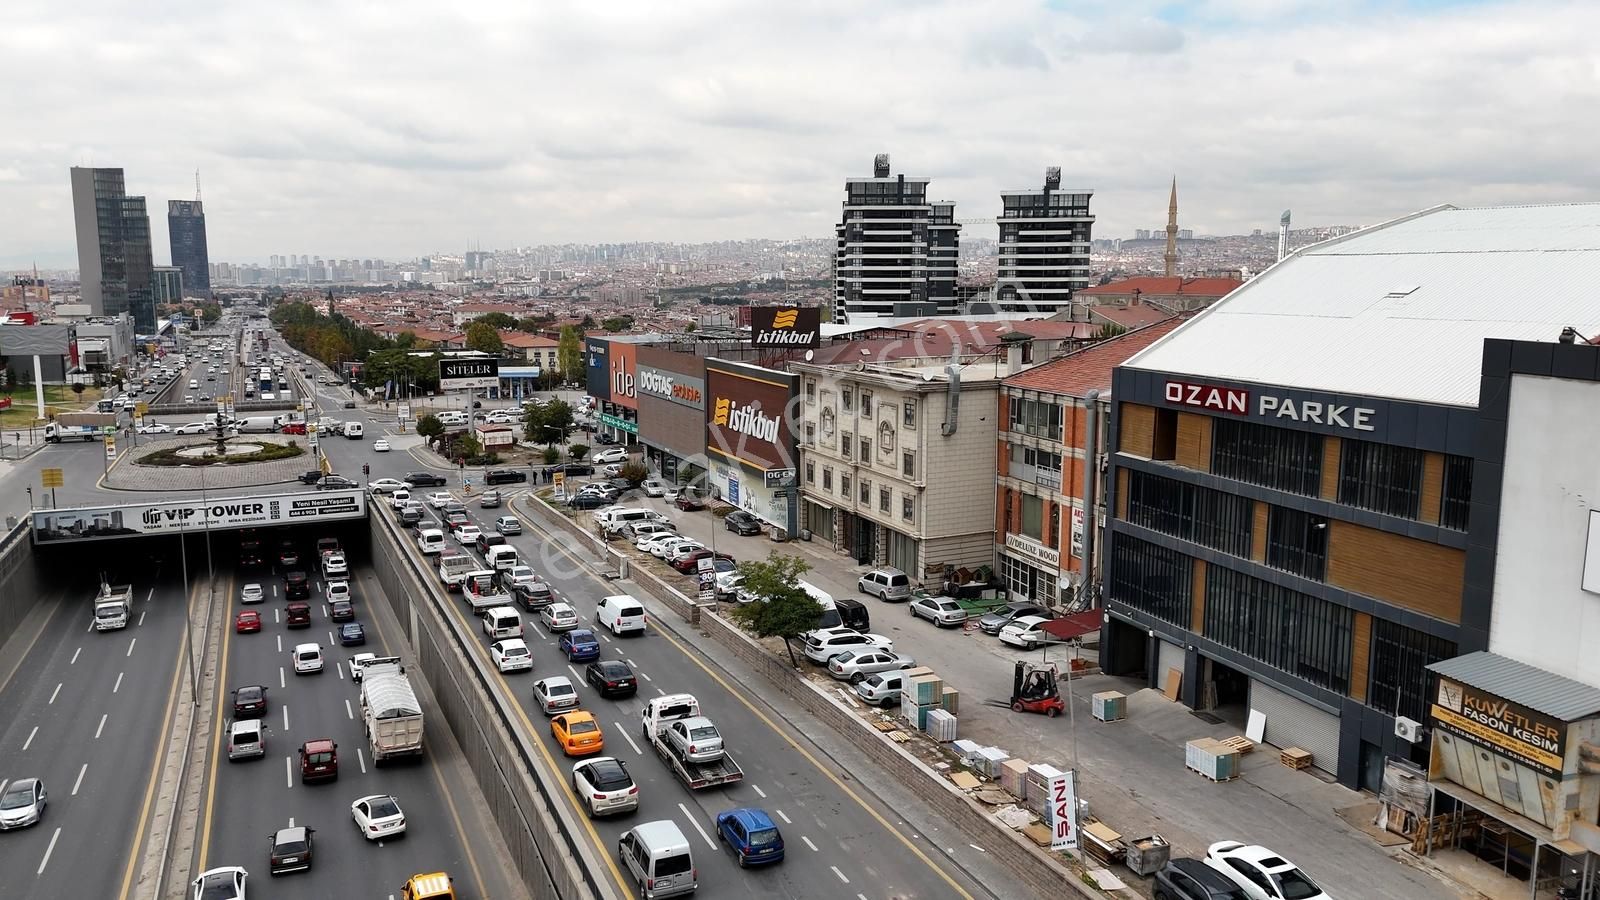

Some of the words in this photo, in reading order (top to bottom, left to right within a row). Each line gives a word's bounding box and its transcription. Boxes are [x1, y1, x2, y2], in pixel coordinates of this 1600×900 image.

[757, 329, 815, 344] istikbal
[446, 364, 491, 375] SİTELER
[641, 369, 673, 400] DOĞTAŞ
[1165, 382, 1246, 412] OZAN
[1259, 395, 1376, 431] PARKE
[728, 400, 781, 444] istikbal
[164, 508, 195, 520] VIP
[202, 503, 264, 517] TOWER
[1015, 540, 1038, 554] DELUXE
[1038, 549, 1058, 563] WOOD
[1463, 707, 1509, 733] FASON
[1512, 726, 1559, 753] KESİM
